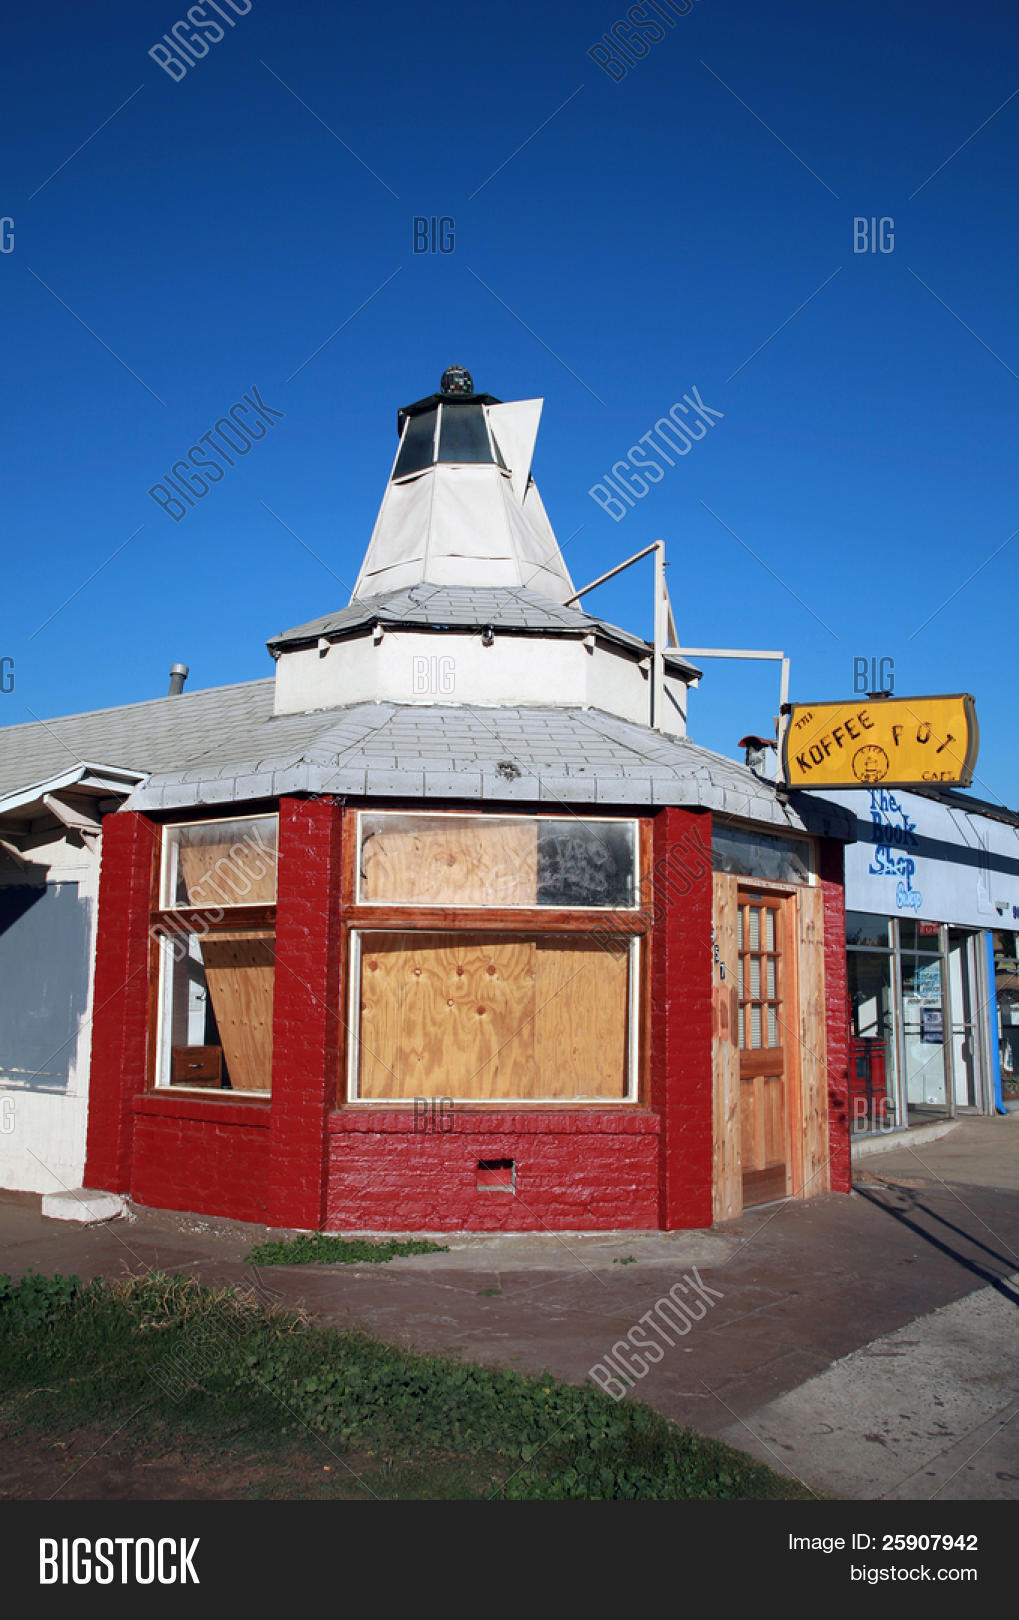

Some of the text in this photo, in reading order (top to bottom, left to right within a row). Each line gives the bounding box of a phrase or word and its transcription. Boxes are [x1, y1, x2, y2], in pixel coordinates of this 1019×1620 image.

[796, 710, 876, 774] KOFFEE
[867, 789, 902, 812] The
[870, 810, 919, 847] Book
[868, 843, 915, 892] Shop
